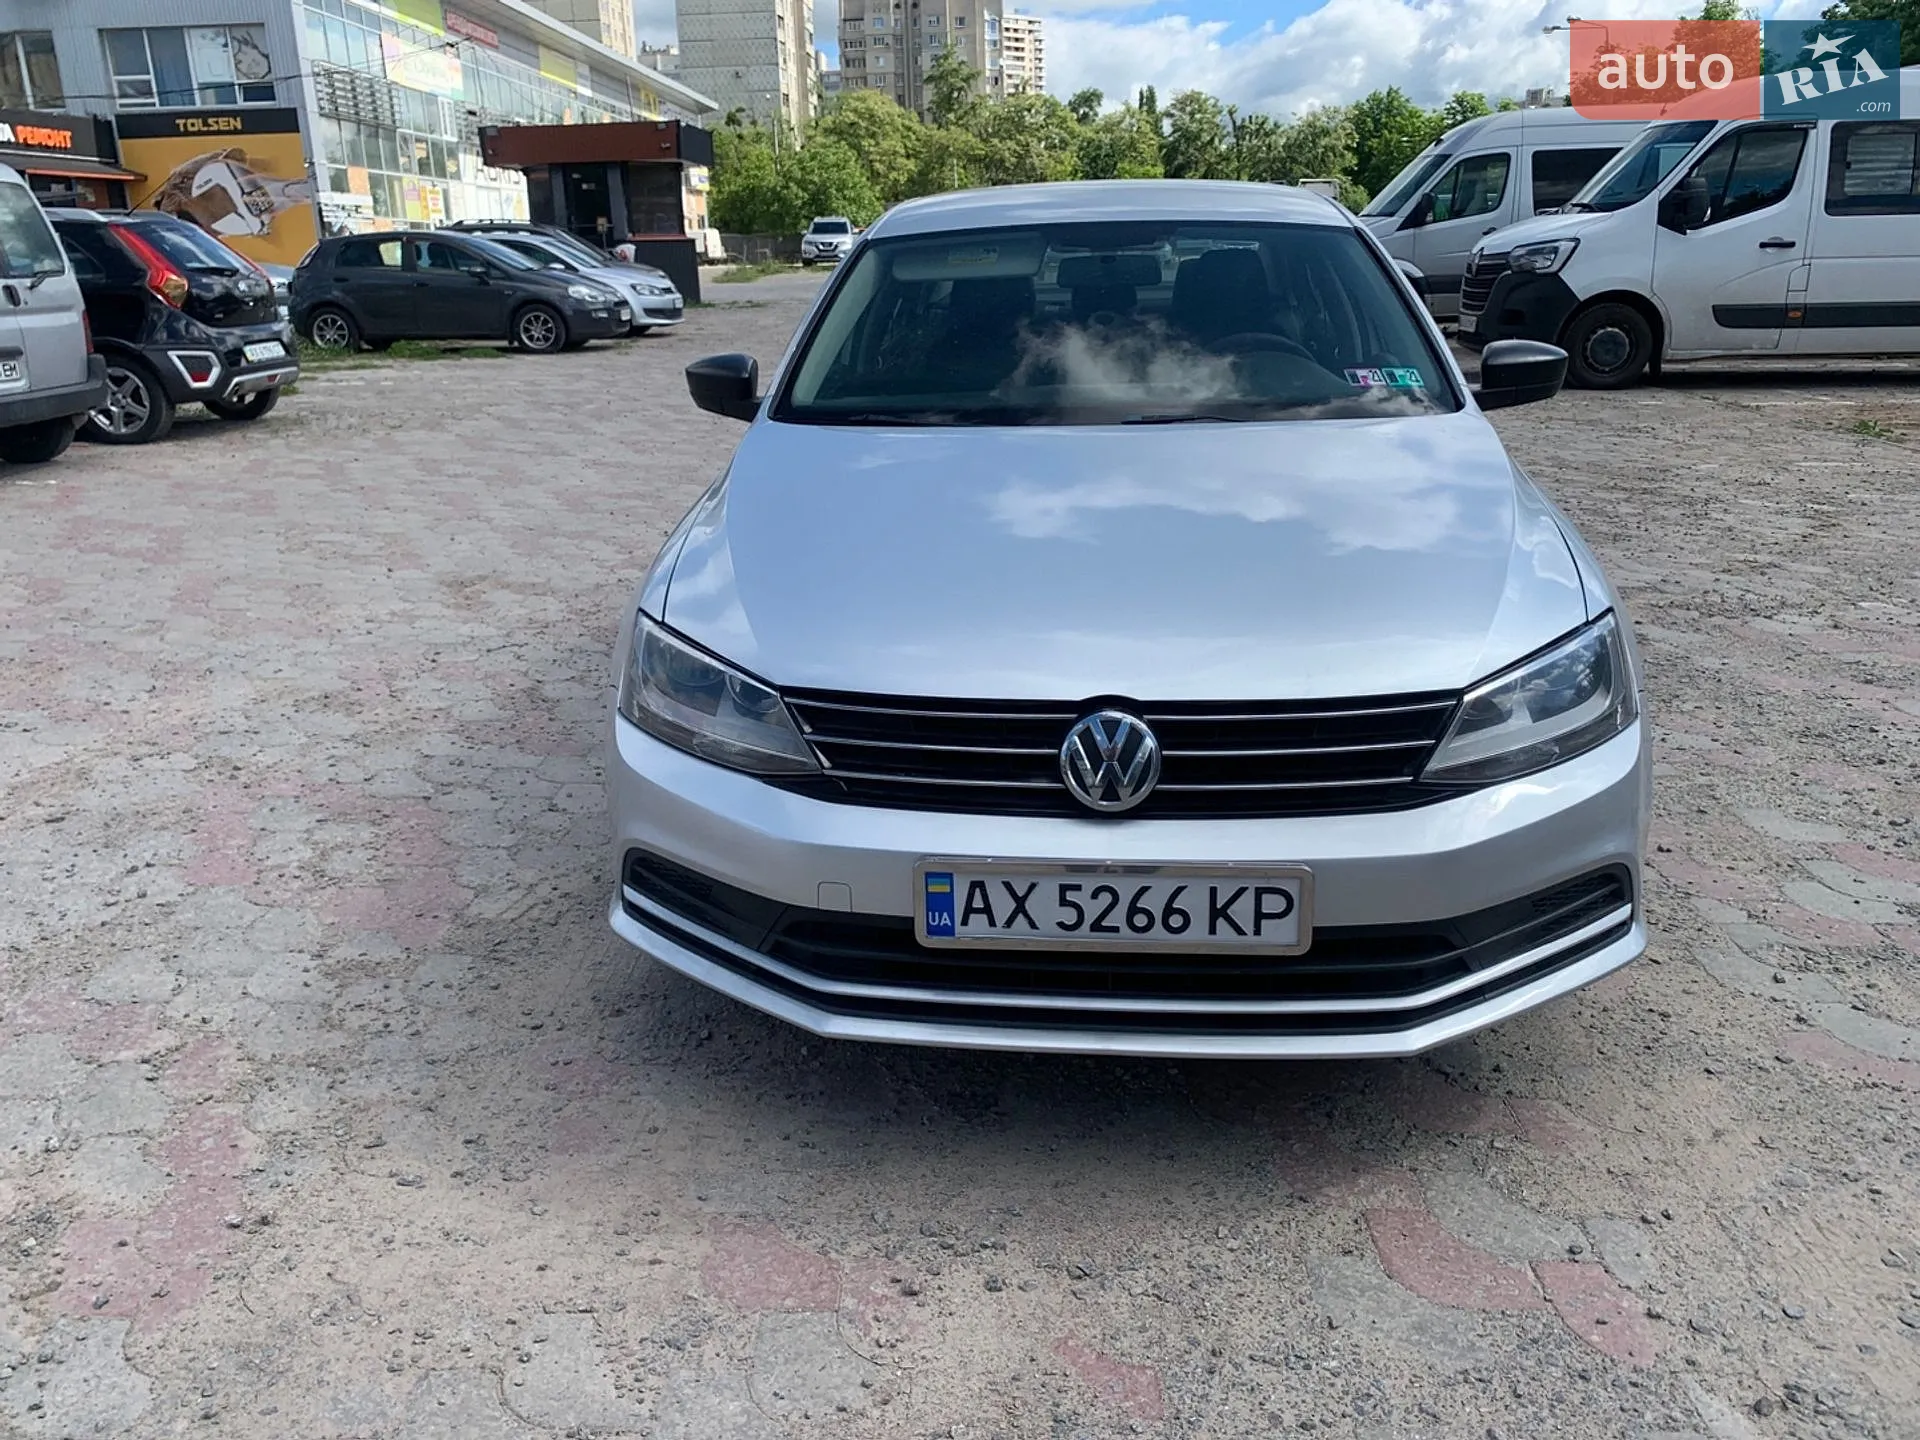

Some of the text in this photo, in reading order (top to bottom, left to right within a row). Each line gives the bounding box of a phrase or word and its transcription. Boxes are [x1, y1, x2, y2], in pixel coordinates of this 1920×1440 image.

[15, 124, 72, 148] РЕМОНТ
[175, 116, 243, 132] TOLSEN
[928, 879, 1295, 937] UA AX 5266 KP
